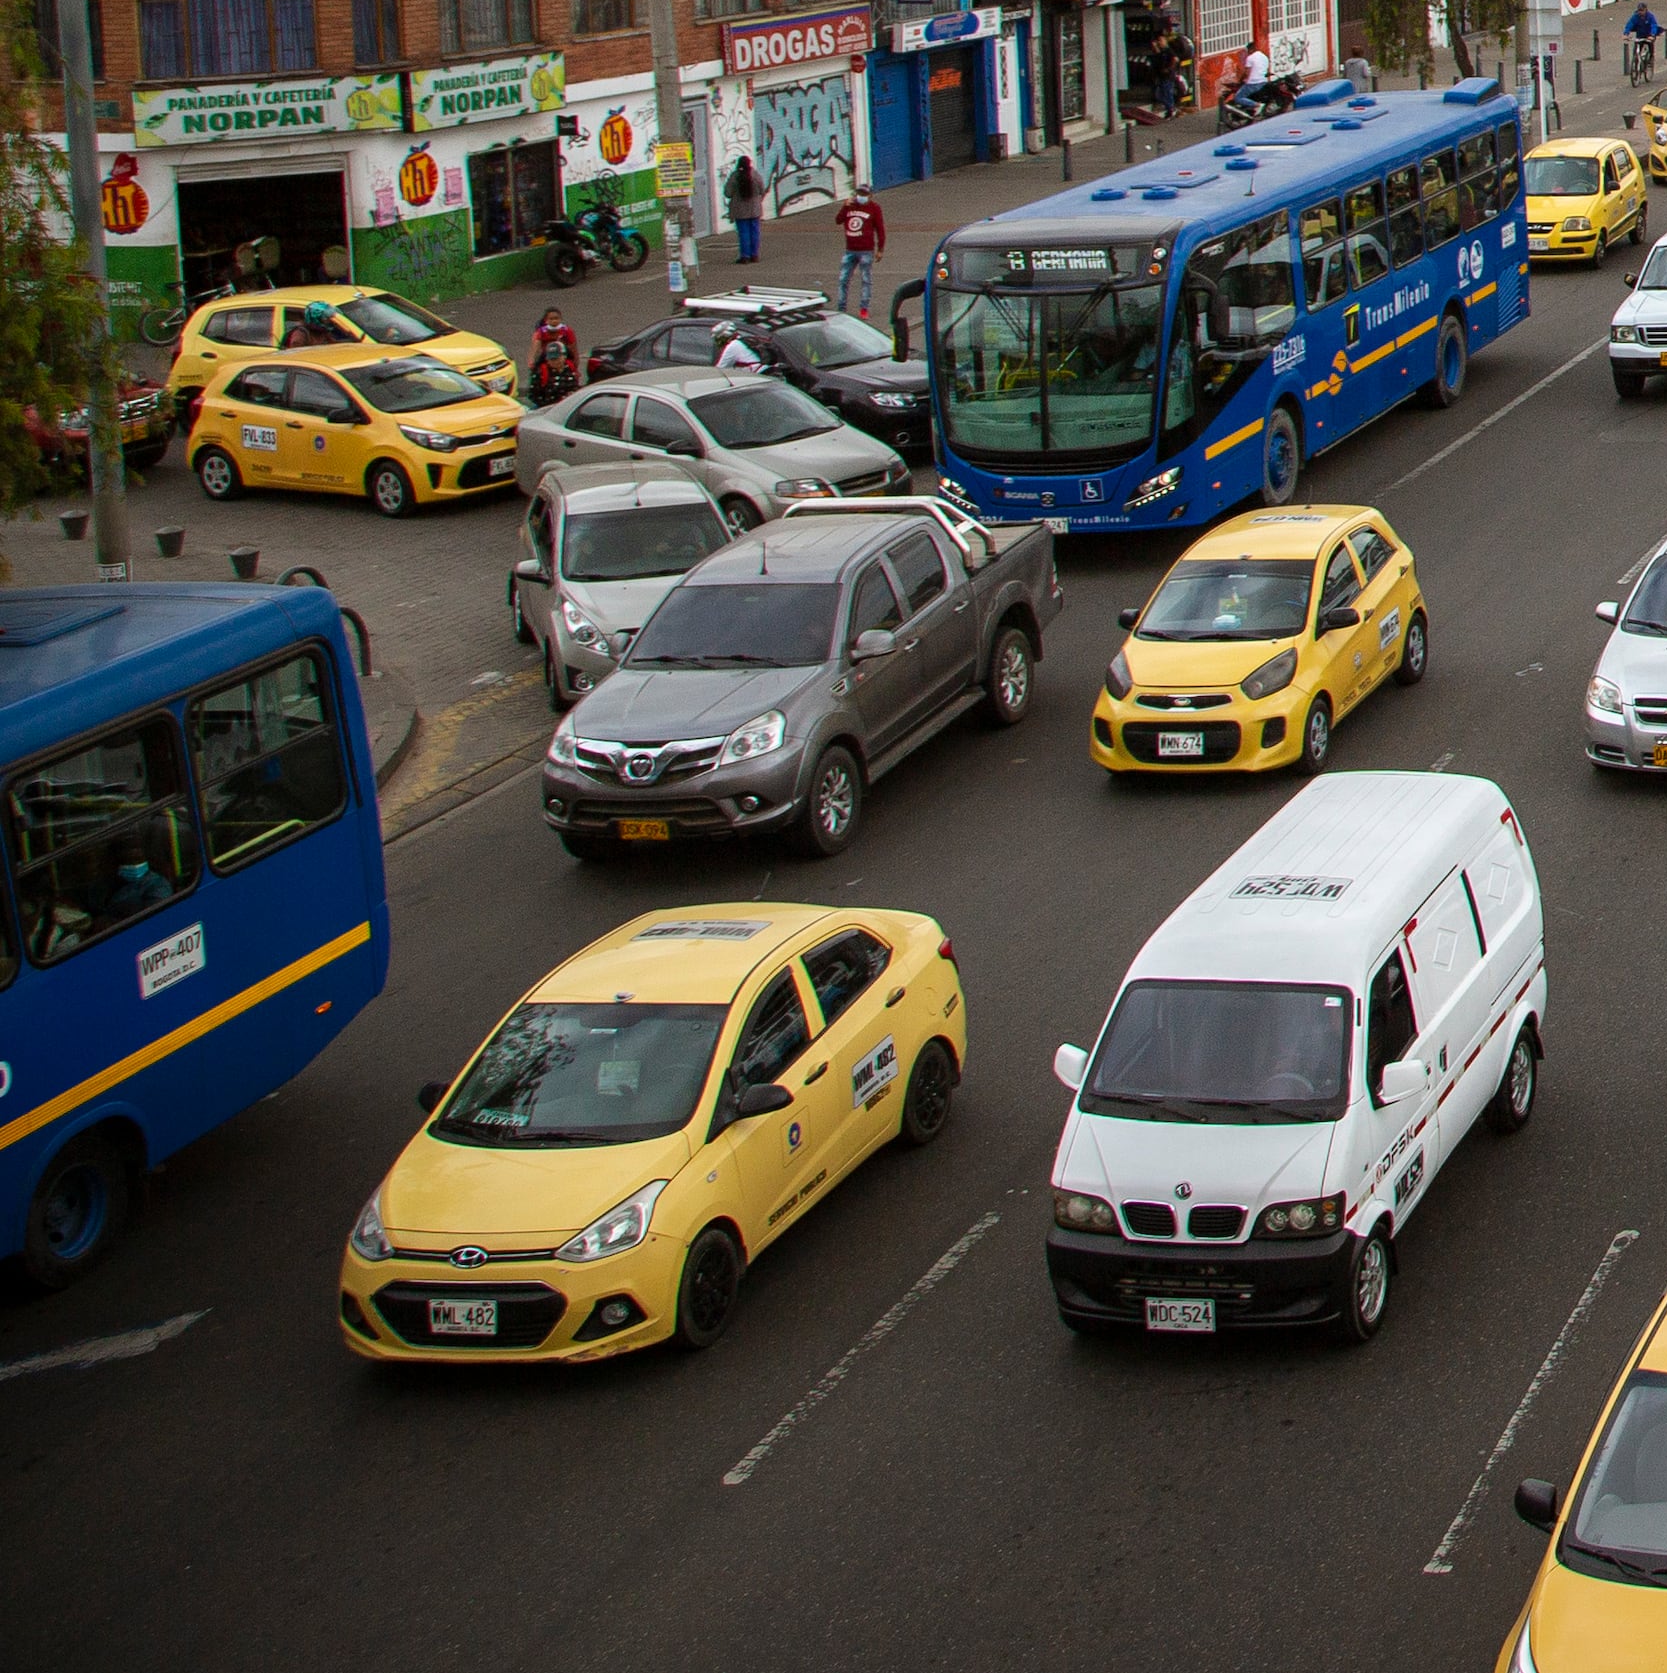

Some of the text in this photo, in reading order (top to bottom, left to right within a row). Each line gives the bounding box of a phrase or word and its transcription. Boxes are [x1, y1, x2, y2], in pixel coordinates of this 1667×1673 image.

[734, 23, 836, 71] DROGAS
[168, 84, 336, 112] PANADERÍA Y CAFETERÍA
[441, 84, 522, 115] NORPAN
[183, 106, 326, 134] NORPAN
[1031, 250, 1107, 270] GERMANIA
[1367, 279, 1429, 331] TransMilenio
[1382, 1124, 1414, 1175] DFSK
